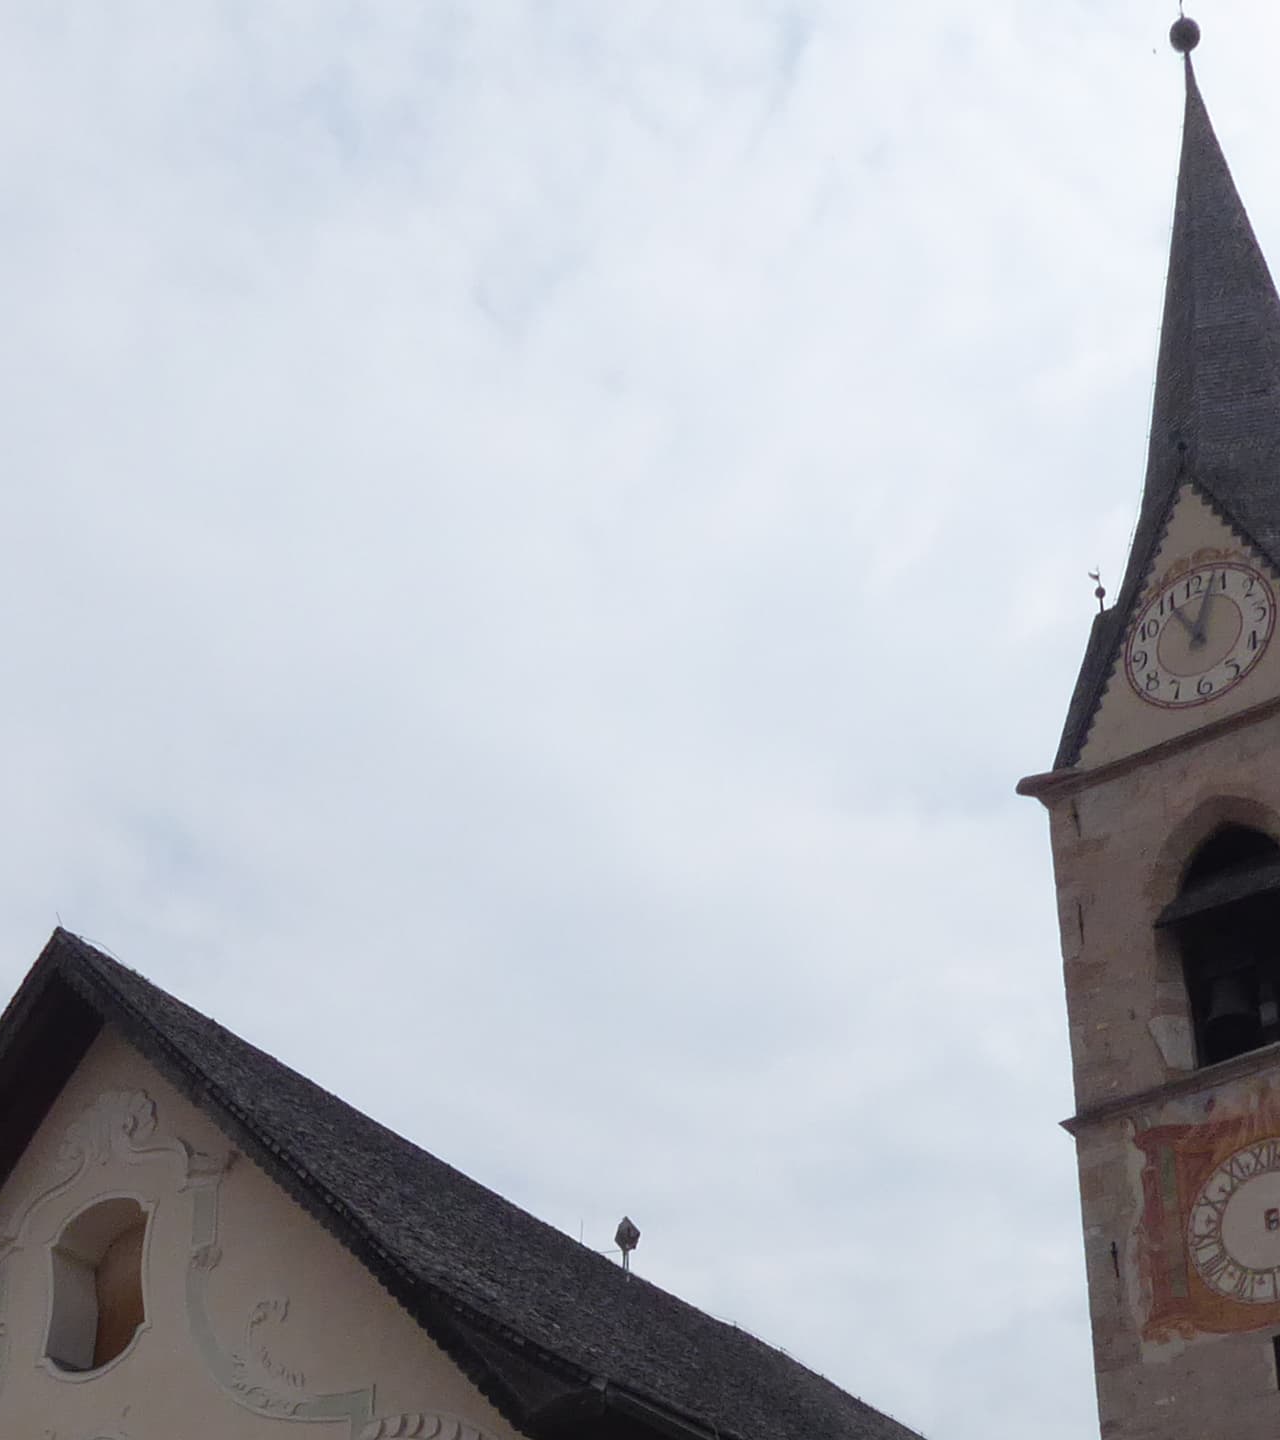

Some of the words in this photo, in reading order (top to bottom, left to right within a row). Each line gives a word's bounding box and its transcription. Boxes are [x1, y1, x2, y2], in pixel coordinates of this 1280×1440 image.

[1185, 575, 1203, 598] 12
[1242, 577, 1254, 598] 2
[1159, 591, 1174, 616] 11
[1140, 618, 1160, 642] 10
[1132, 651, 1148, 671] 9
[1145, 671, 1160, 692] 8
[1170, 680, 1181, 700] 7
[1196, 676, 1213, 695] 6
